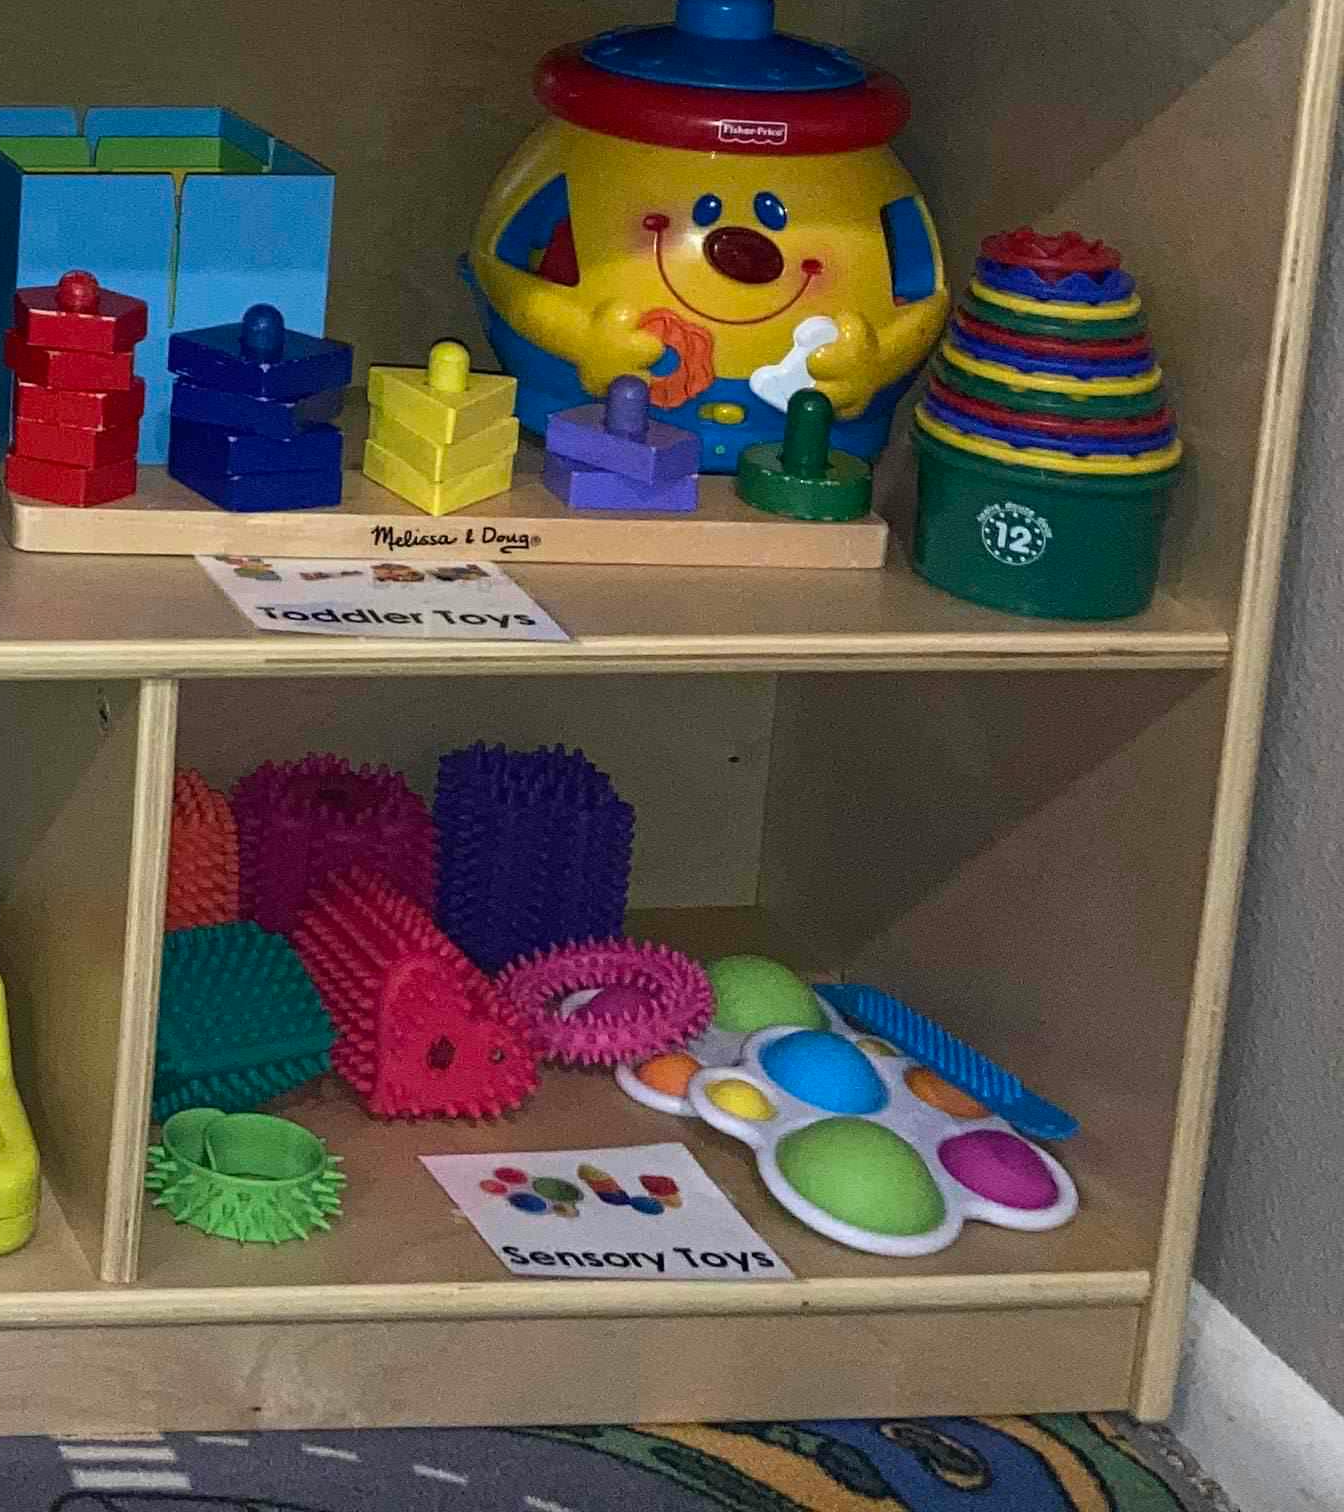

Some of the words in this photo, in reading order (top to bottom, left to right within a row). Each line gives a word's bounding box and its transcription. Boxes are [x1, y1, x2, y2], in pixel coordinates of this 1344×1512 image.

[371, 526, 457, 551] Melissa
[482, 527, 530, 554] Doug
[995, 520, 1032, 554] 12
[257, 606, 424, 625] Toddler
[432, 609, 536, 629] Toys
[502, 1246, 665, 1273] Sensory
[673, 1248, 775, 1273] Toys
